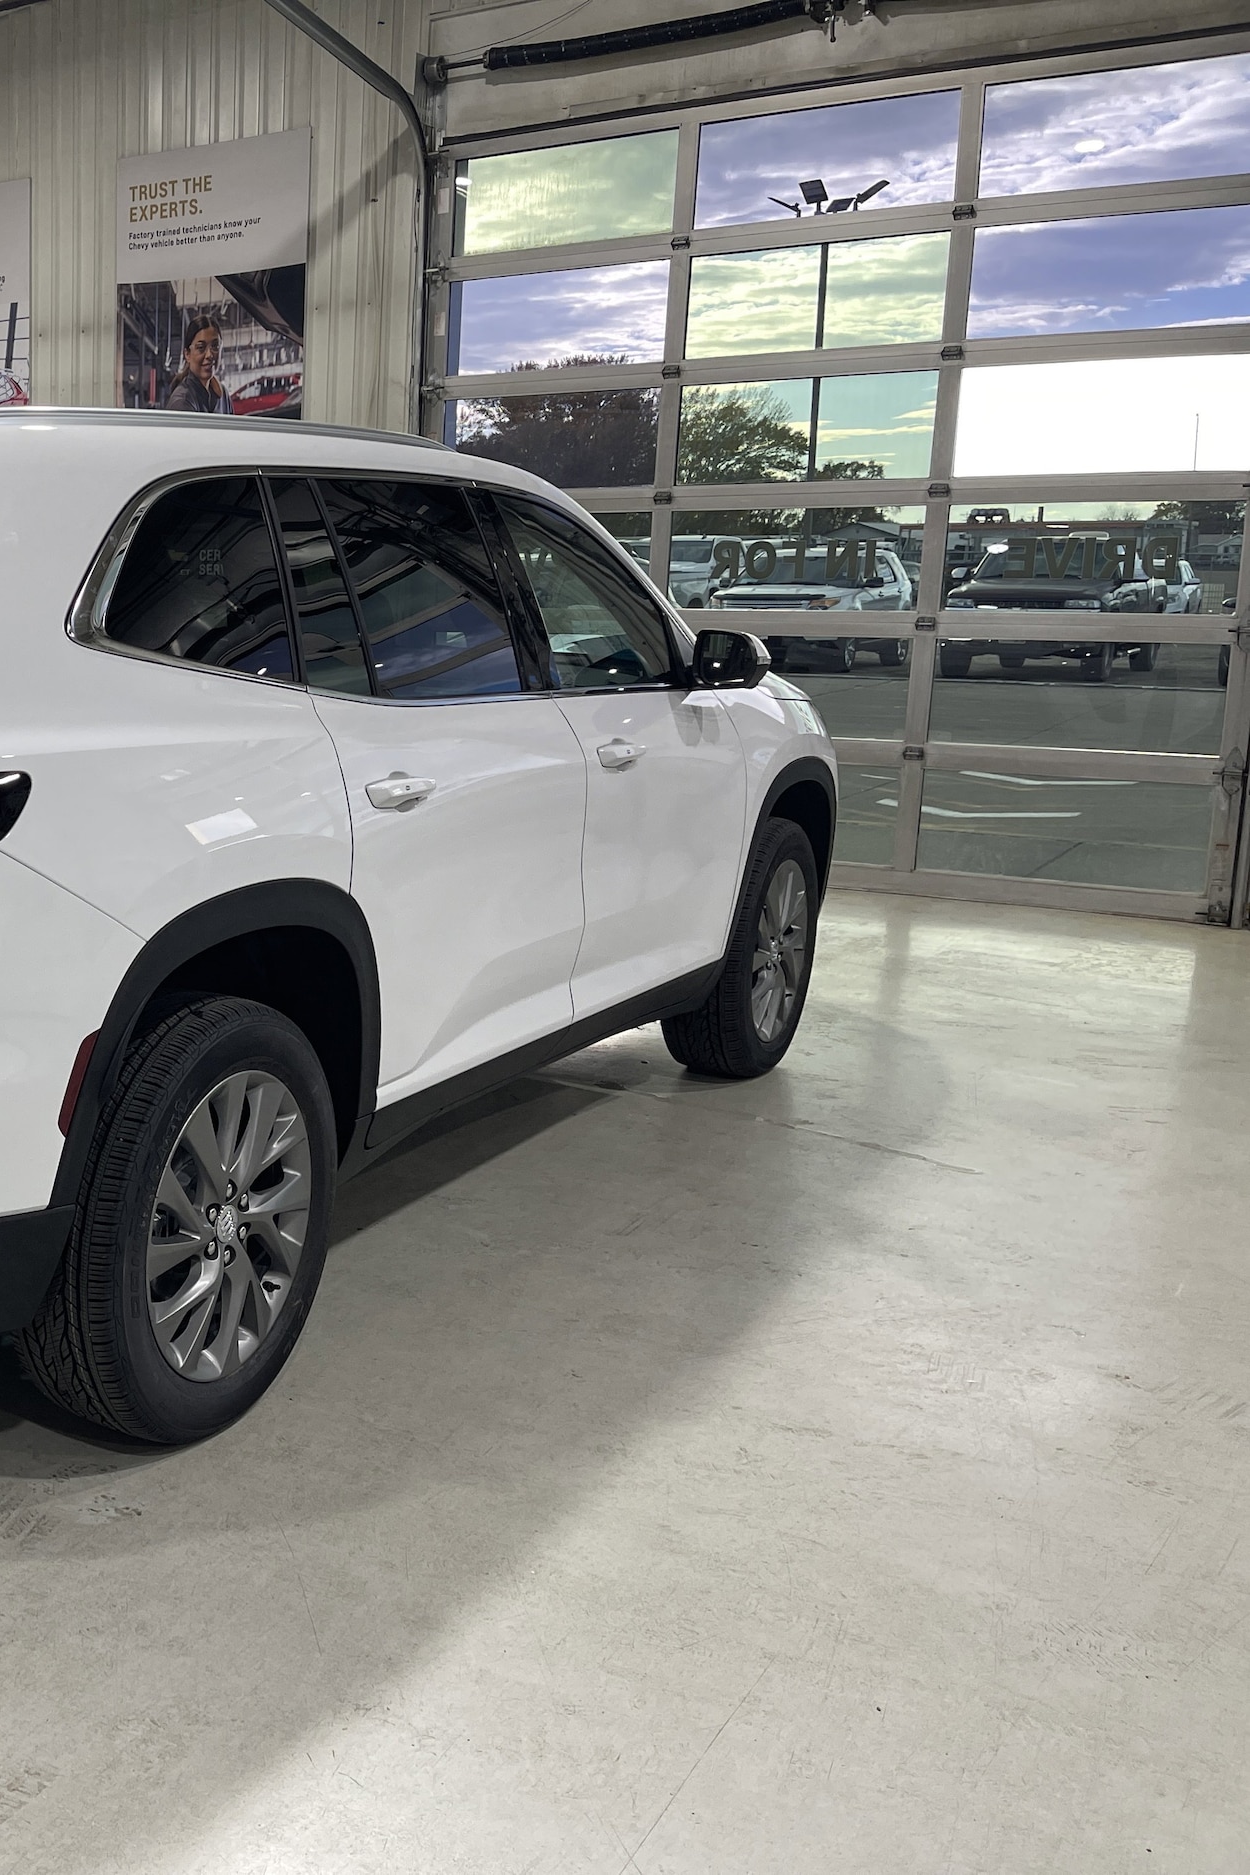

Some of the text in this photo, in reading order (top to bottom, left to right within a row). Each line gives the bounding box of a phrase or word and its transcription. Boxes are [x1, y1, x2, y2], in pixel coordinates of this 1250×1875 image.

[129, 175, 213, 202] TRUST THE
[129, 199, 203, 223] EXPERTS.
[129, 217, 261, 241] Factory trained technicians know your
[129, 231, 244, 251] Chevy vehicle better than anyone.
